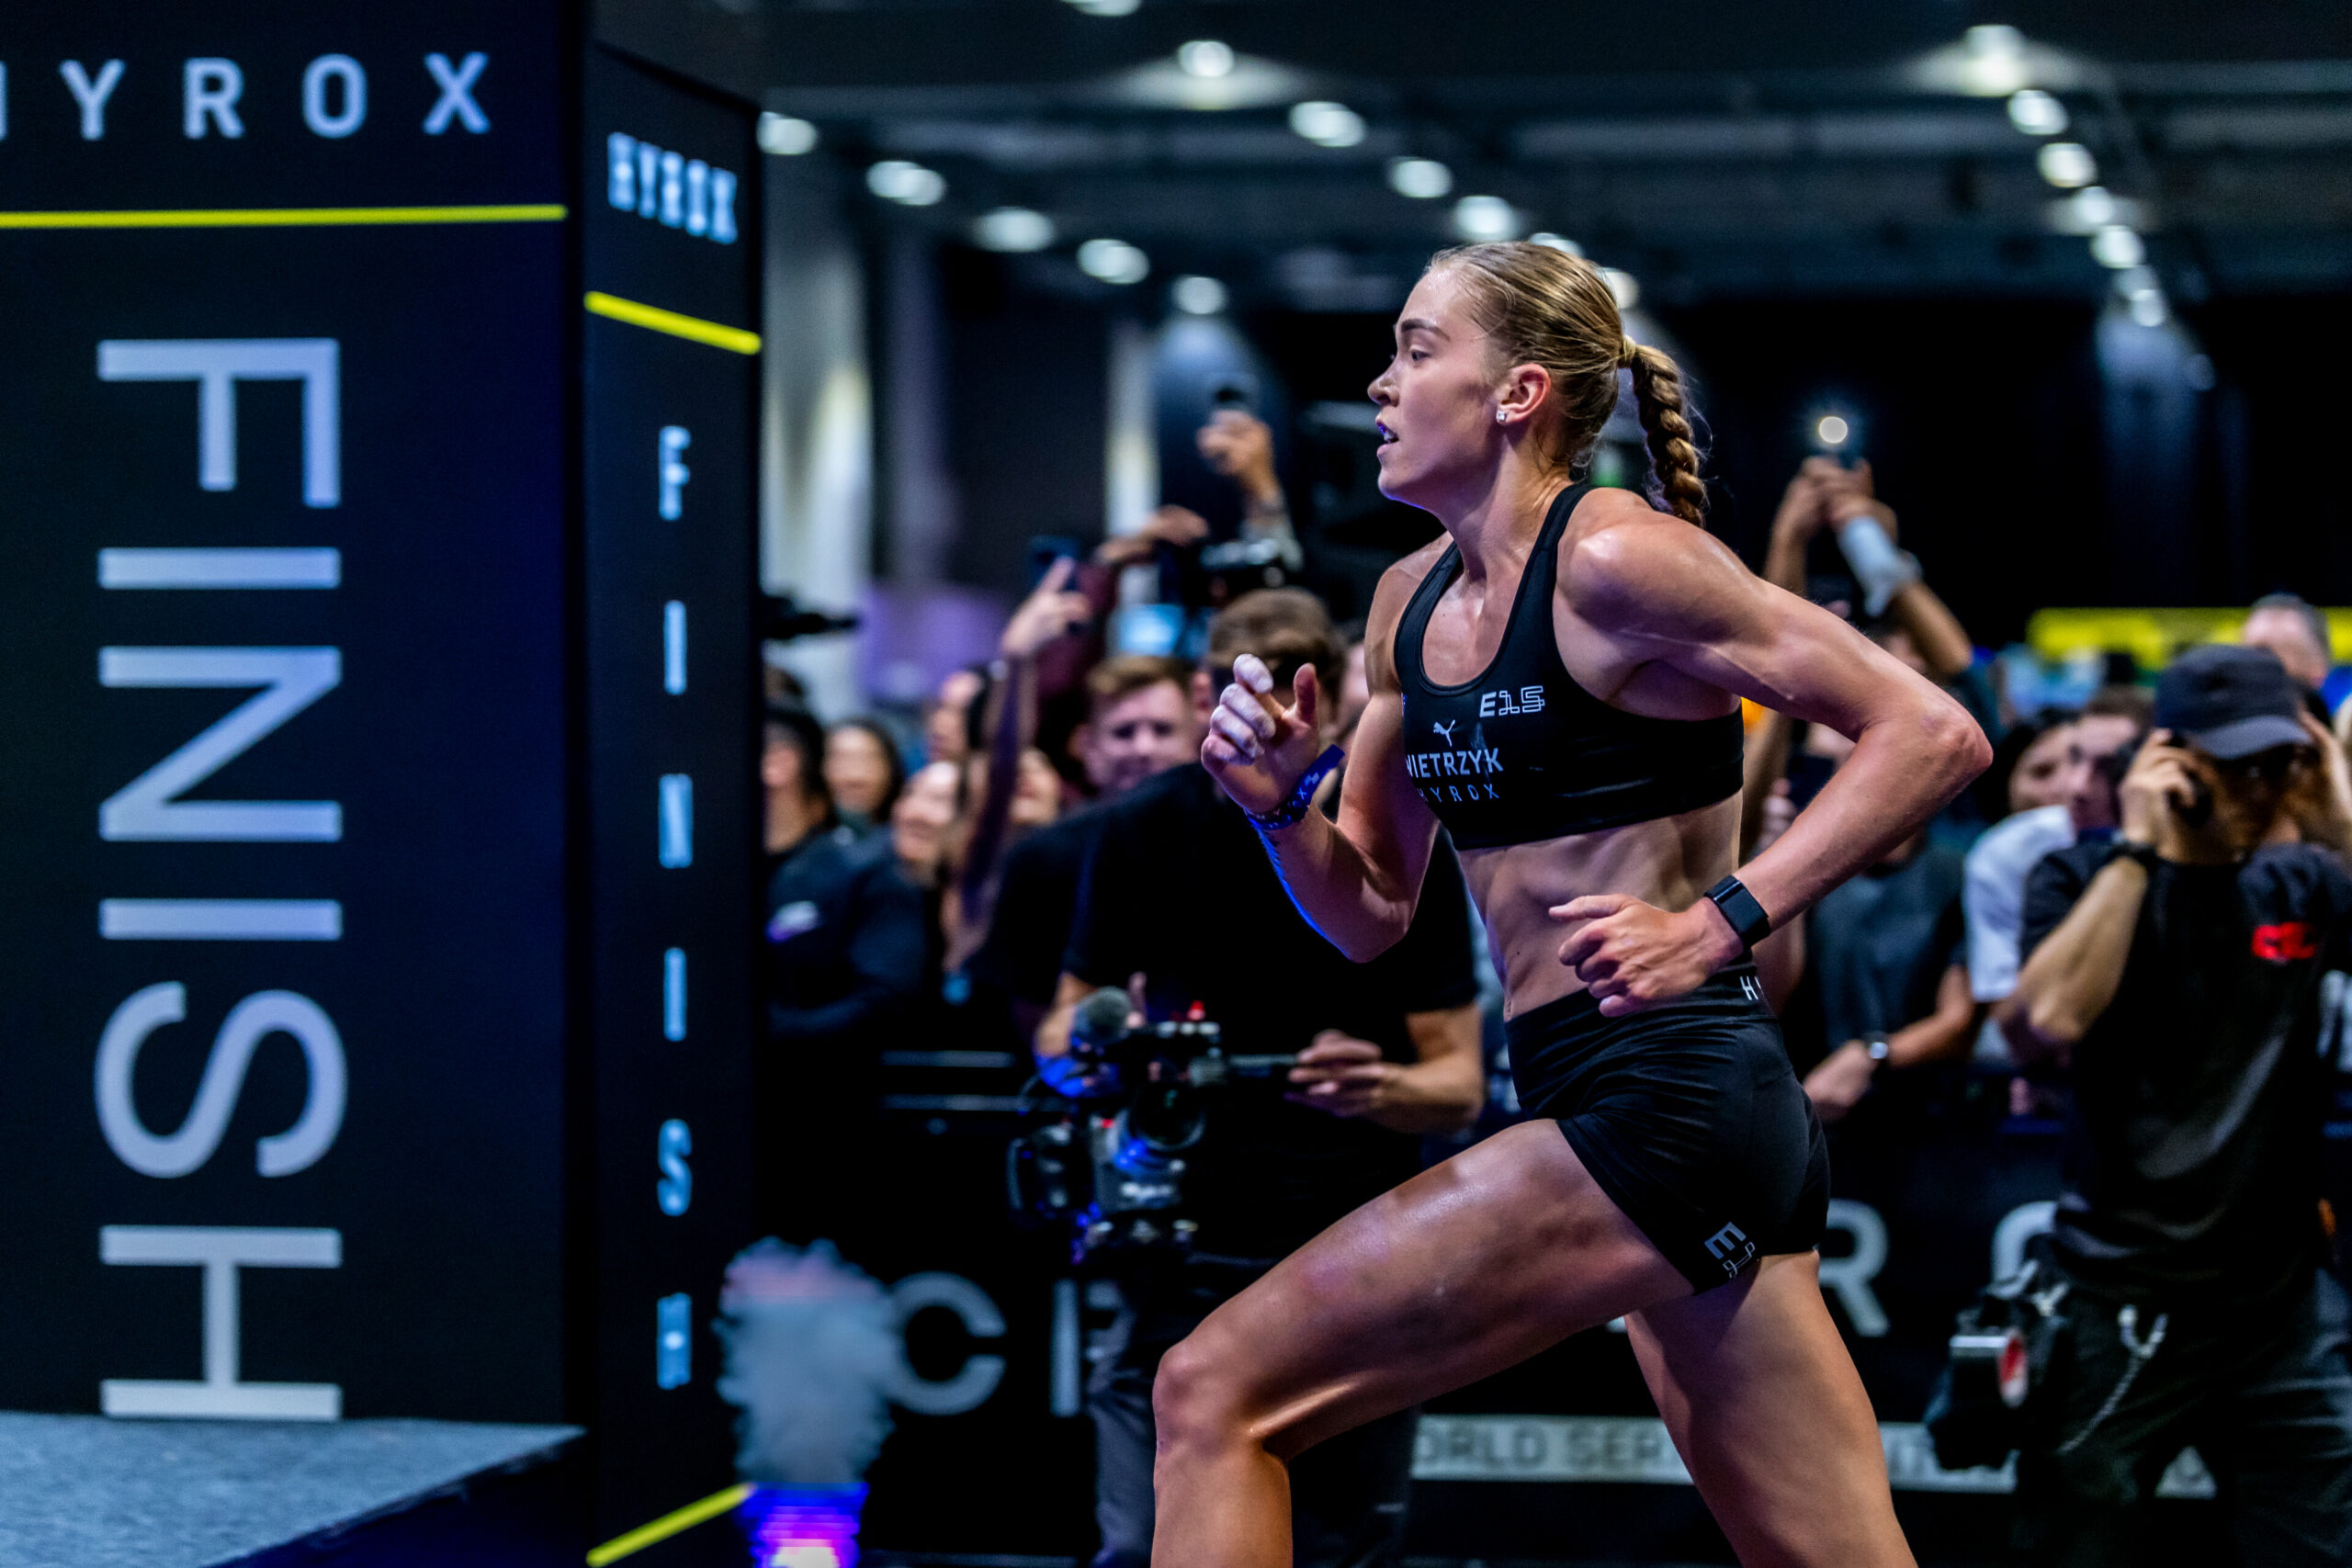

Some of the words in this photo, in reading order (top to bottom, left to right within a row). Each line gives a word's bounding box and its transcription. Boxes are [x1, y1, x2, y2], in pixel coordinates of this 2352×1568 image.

[0, 51, 491, 141] YROX
[1478, 684, 1546, 718] E15
[95, 337, 346, 1422] FINISH
